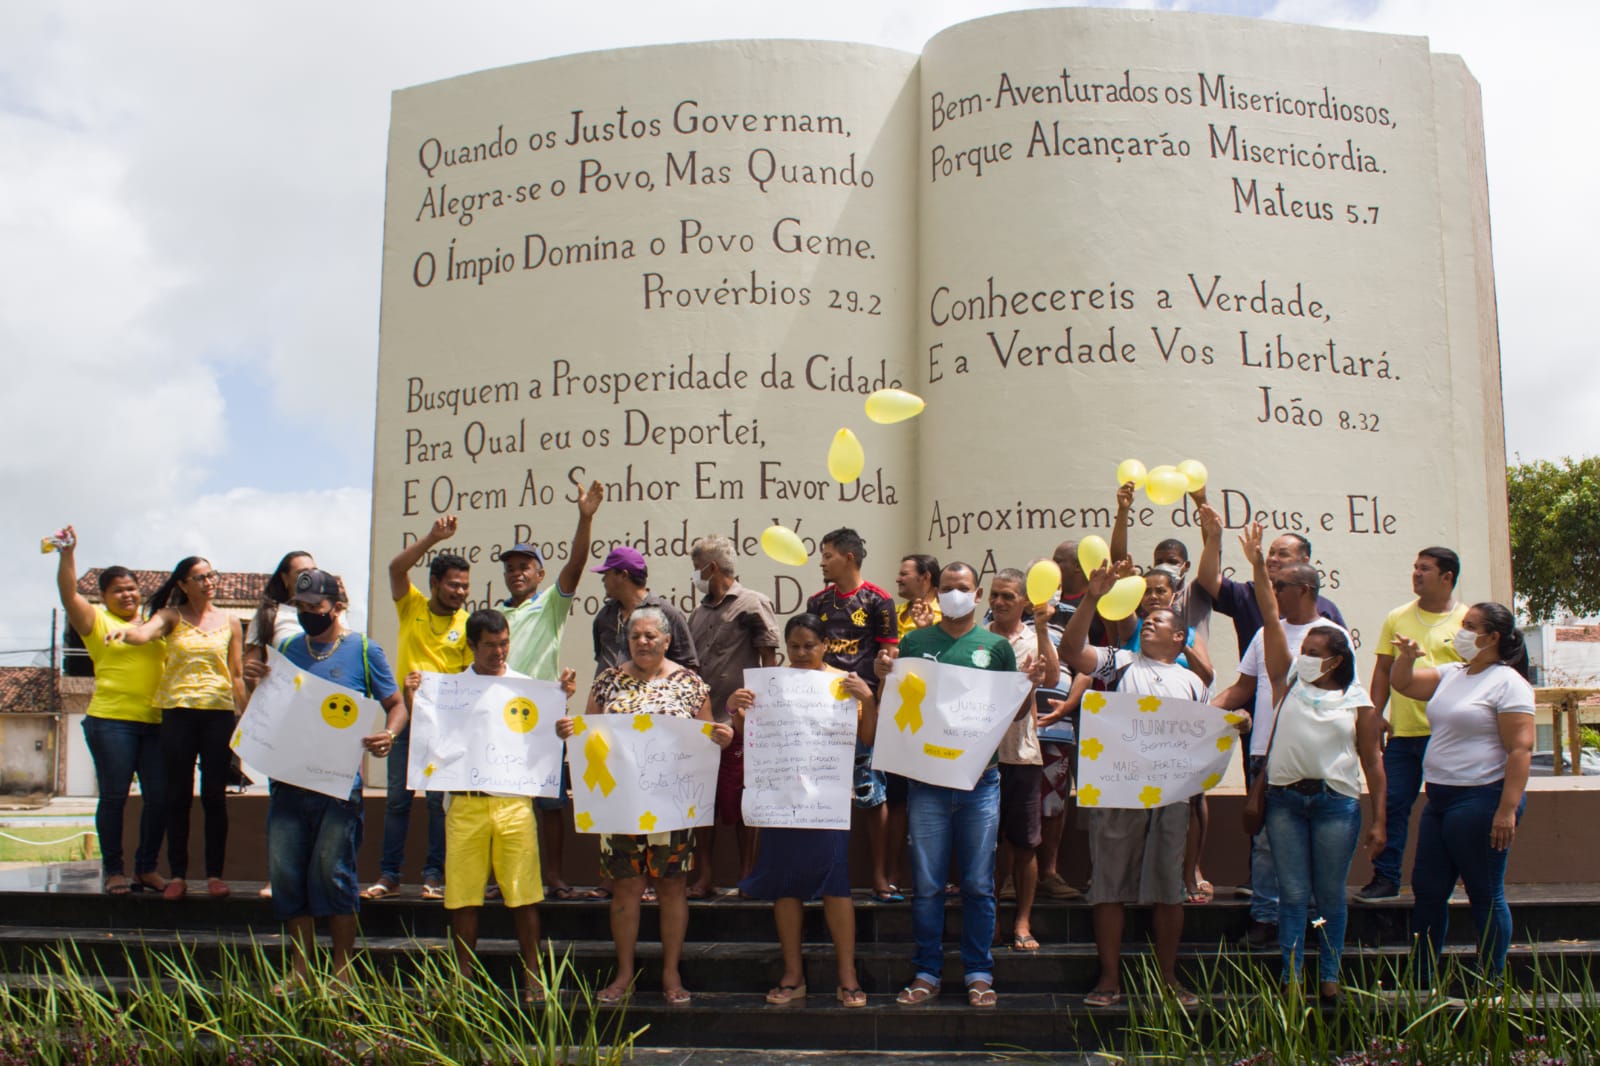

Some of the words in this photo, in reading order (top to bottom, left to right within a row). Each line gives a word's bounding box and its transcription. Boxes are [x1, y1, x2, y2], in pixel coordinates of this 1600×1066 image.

[931, 68, 1158, 131] Bem-Aventurados
[1164, 83, 1192, 106] os
[1198, 72, 1397, 130] Misericordiosos,
[418, 125, 518, 178] Quando
[528, 128, 557, 151] os
[565, 105, 661, 146] Justos
[673, 100, 852, 138] Governam,
[931, 138, 1013, 183] Porque
[1208, 123, 1387, 174] Misericórdia.
[551, 178, 565, 197] o
[579, 159, 655, 194] Povo,
[665, 151, 731, 187] Mas
[747, 148, 875, 193] Quando
[1231, 177, 1334, 221] Mateus
[1347, 206, 1380, 225] 5.7
[412, 252, 436, 287] O
[446, 238, 515, 286] Ímpio
[523, 233, 636, 270] Domina
[650, 236, 665, 256] o
[680, 219, 755, 255] Povo
[772, 218, 877, 260] Geme.
[642, 270, 811, 310] Provérbios
[828, 289, 882, 315] 29.2
[930, 276, 1135, 327] Conhecereis
[1157, 286, 1173, 310] a
[1187, 273, 1331, 323] Verdade,
[929, 343, 944, 384] E
[954, 354, 970, 375] a
[987, 326, 1136, 369] Verdade
[1151, 327, 1215, 366] Vos
[1240, 331, 1401, 381] Libertará.
[406, 374, 519, 415] Busquem
[529, 378, 542, 400] a
[552, 353, 749, 403] Prosperidade
[760, 352, 795, 391] da
[1257, 385, 1323, 427] João
[1339, 411, 1381, 433] 8.32
[404, 428, 454, 465] Para
[463, 418, 526, 463] Qual
[540, 428, 571, 452] eu
[582, 424, 610, 448] os
[623, 408, 766, 455] Deportei,
[402, 479, 421, 516] E
[431, 475, 507, 514] Orem
[519, 469, 554, 508] Ao
[565, 464, 681, 504] Snhor
[694, 461, 744, 500] Em
[759, 461, 829, 500] Favor
[838, 467, 898, 506] Dela
[1220, 489, 1311, 534] Deus,
[1320, 512, 1334, 532] e
[1347, 495, 1397, 535] Ele
[490, 544, 502, 562] a
[514, 519, 702, 561] Poseridad
[1121, 718, 1207, 742] JUNTOS
[1112, 760, 1138, 772] MAIS
